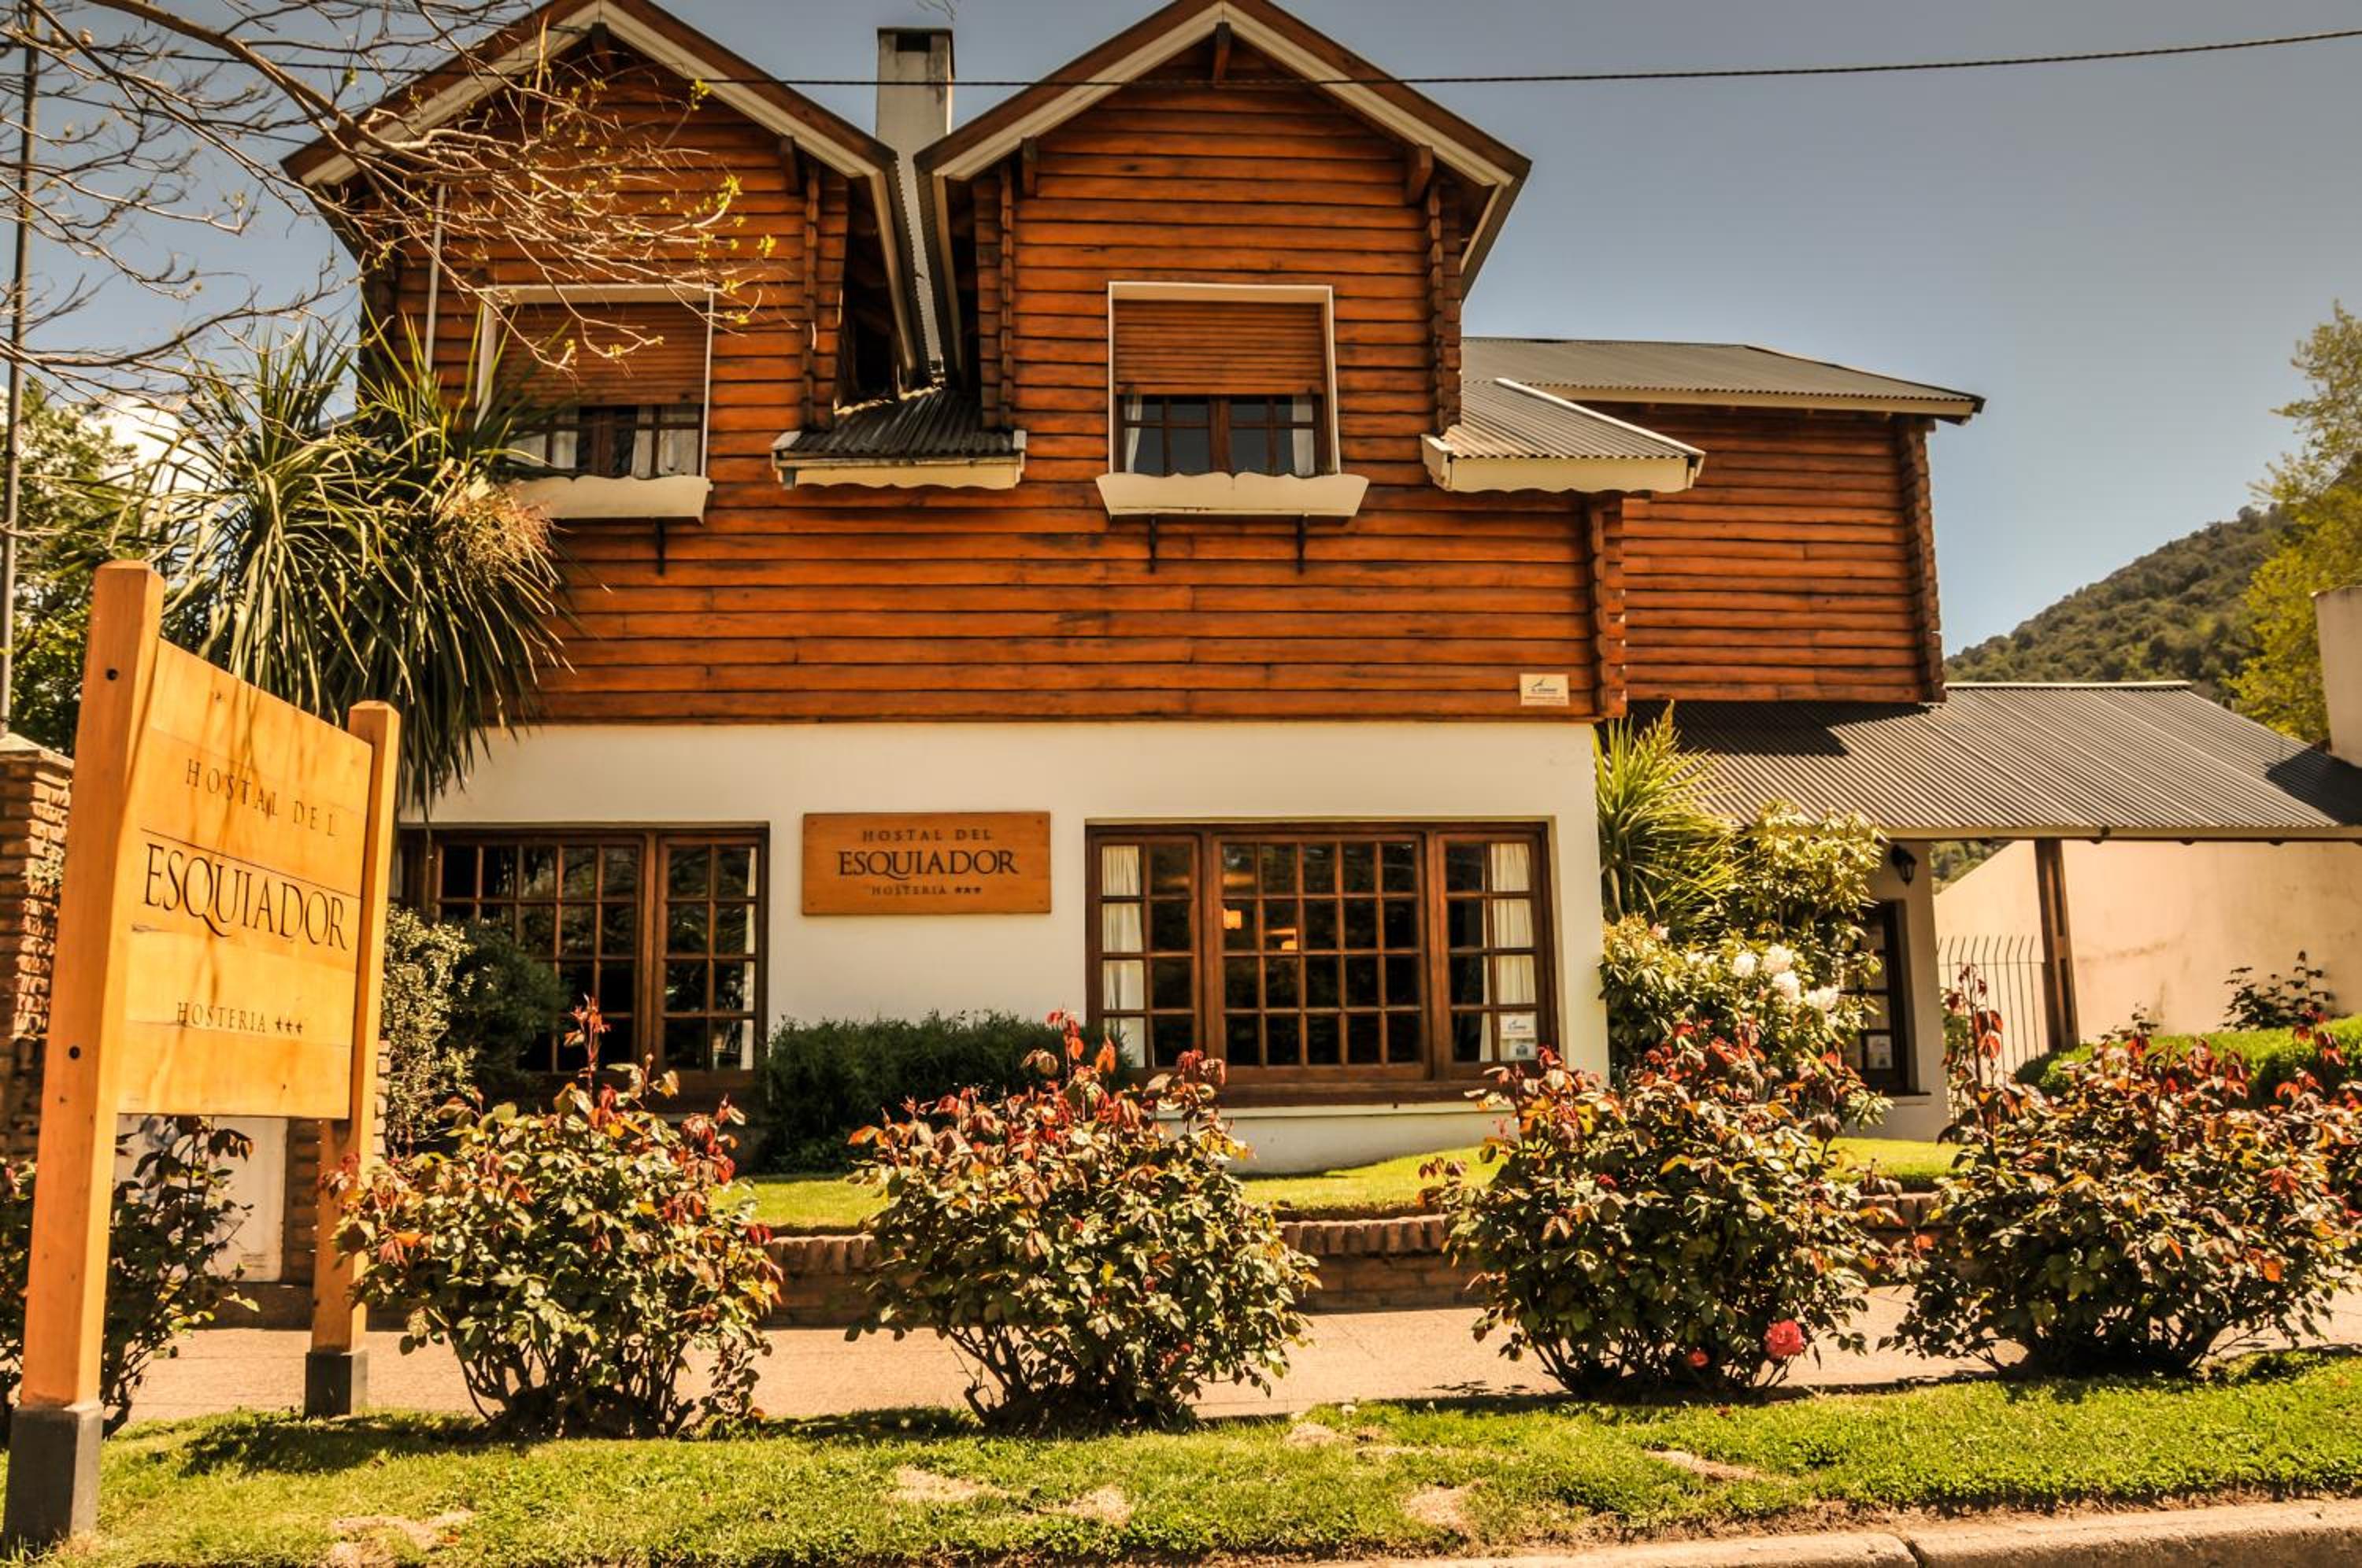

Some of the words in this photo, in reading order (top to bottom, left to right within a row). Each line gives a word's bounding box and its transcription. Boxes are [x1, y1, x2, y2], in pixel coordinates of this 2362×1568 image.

[186, 759, 278, 815] HOSTAL
[294, 800, 337, 836] DEL
[862, 830, 942, 841] HOSTAL
[956, 829, 994, 841] DEL
[838, 850, 1020, 880] ESQUIADOR
[143, 843, 347, 951] ESQUIADOR
[872, 886, 946, 895] HOSTERIA
[177, 1002, 267, 1034] HOSTERIA
